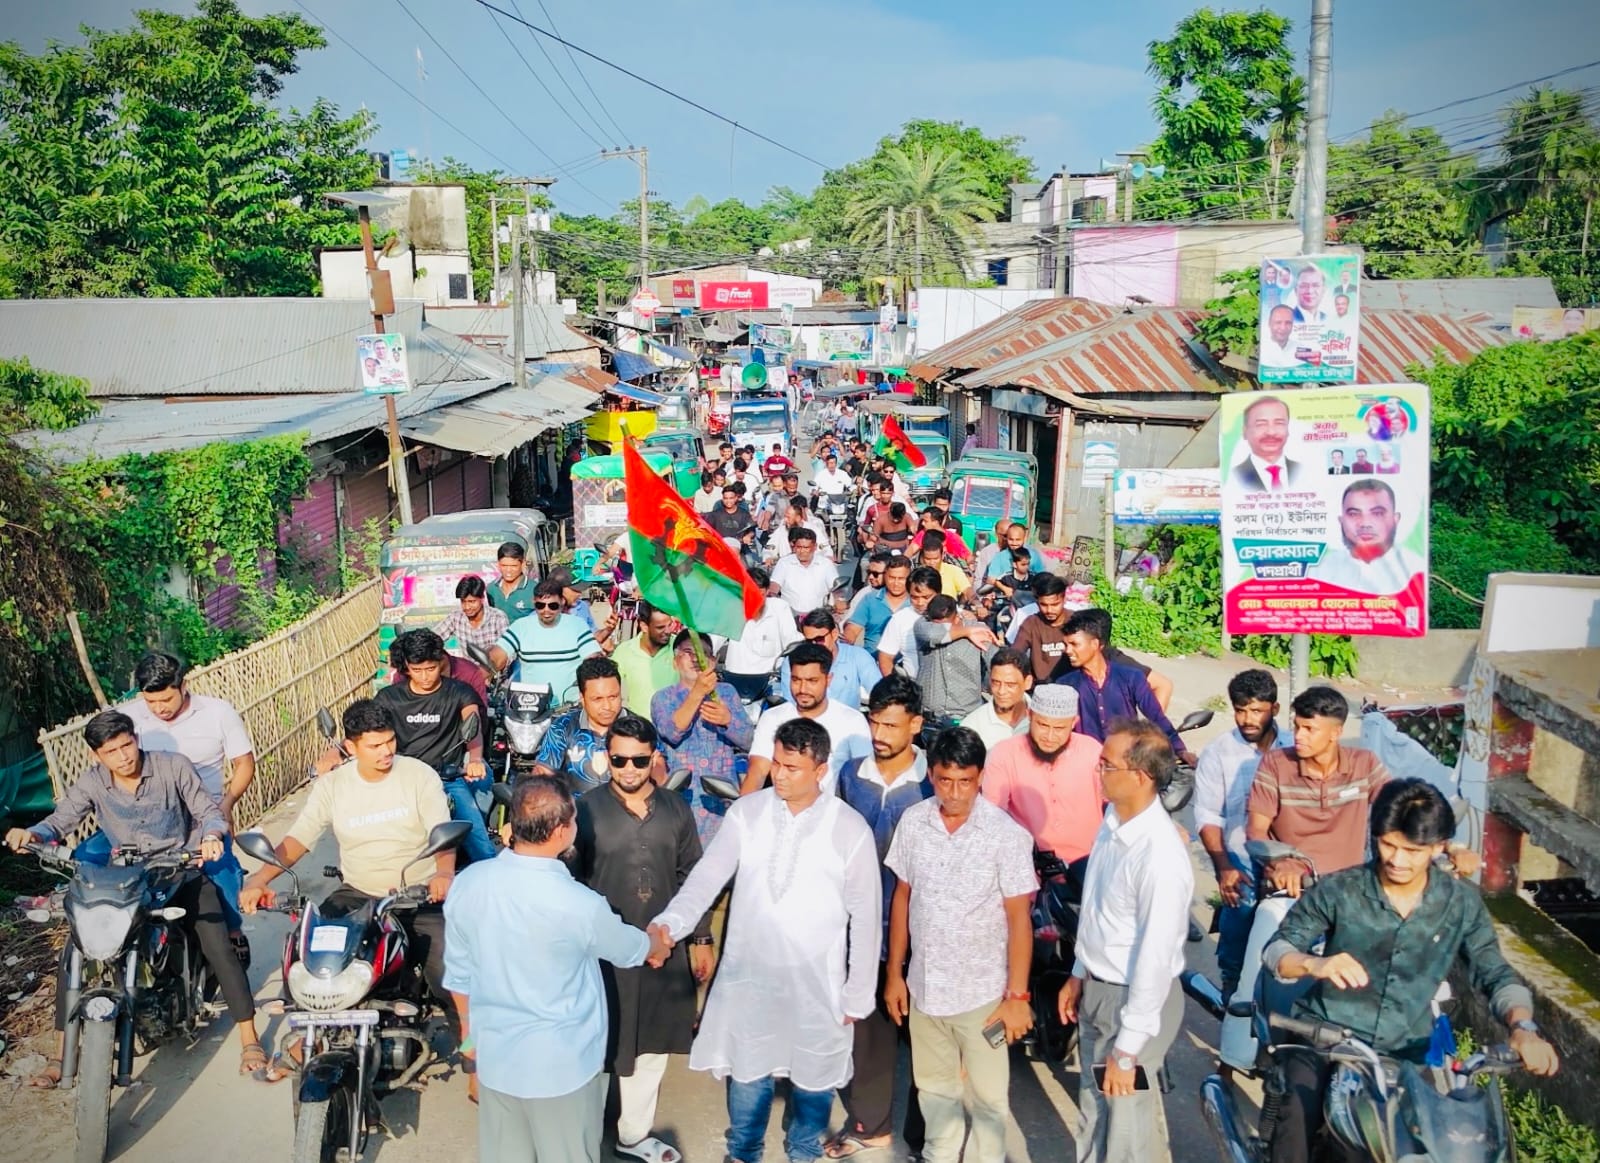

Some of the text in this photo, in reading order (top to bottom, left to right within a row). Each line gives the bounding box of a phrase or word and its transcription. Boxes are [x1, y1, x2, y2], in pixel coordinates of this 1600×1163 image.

[1233, 514, 1258, 524] ঝলম
[1287, 510, 1327, 523] ইউনিয়ন
[1239, 544, 1320, 560] চেয়ারম্যান
[406, 713, 441, 724] adidas
